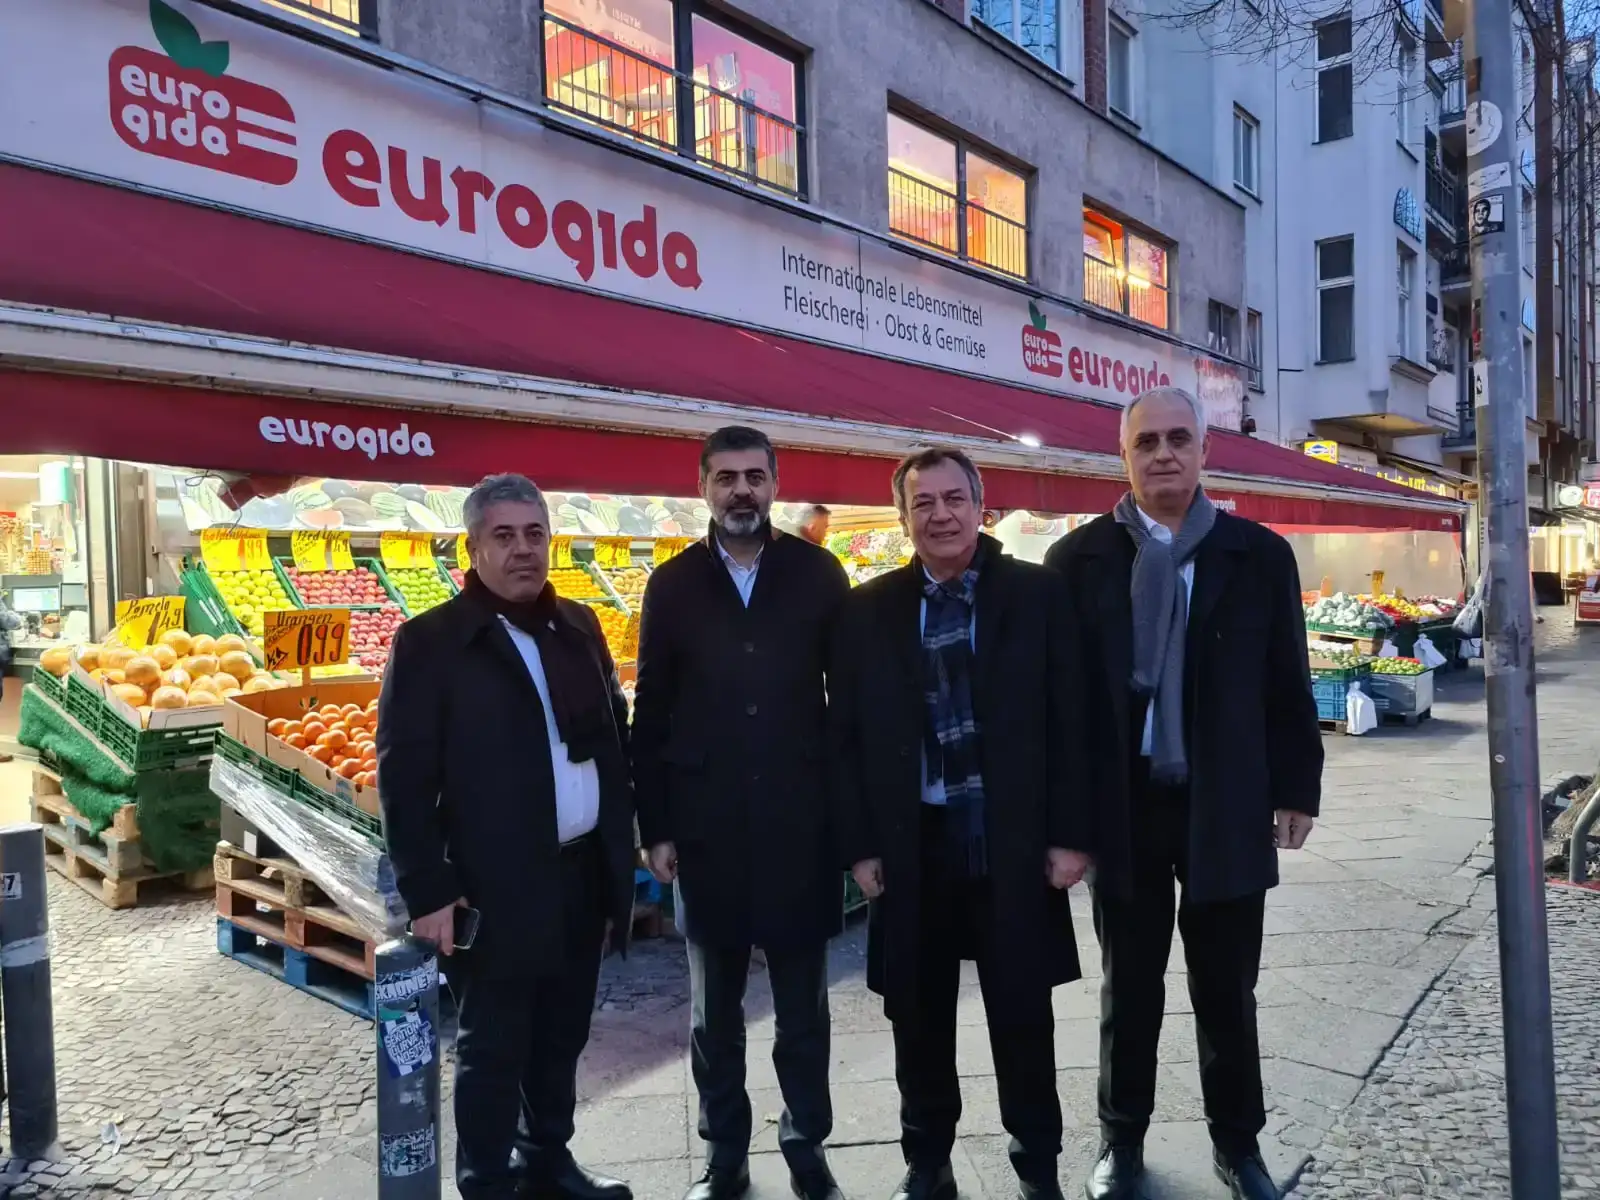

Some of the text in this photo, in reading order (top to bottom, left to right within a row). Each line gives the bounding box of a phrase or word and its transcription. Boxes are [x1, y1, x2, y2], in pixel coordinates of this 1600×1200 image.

[120, 64, 230, 119] euro
[782, 246, 983, 327] Internationale Lebensmittel
[784, 285, 986, 359] Fleischerei Obst & Gemüse
[1024, 332, 1048, 348] euro
